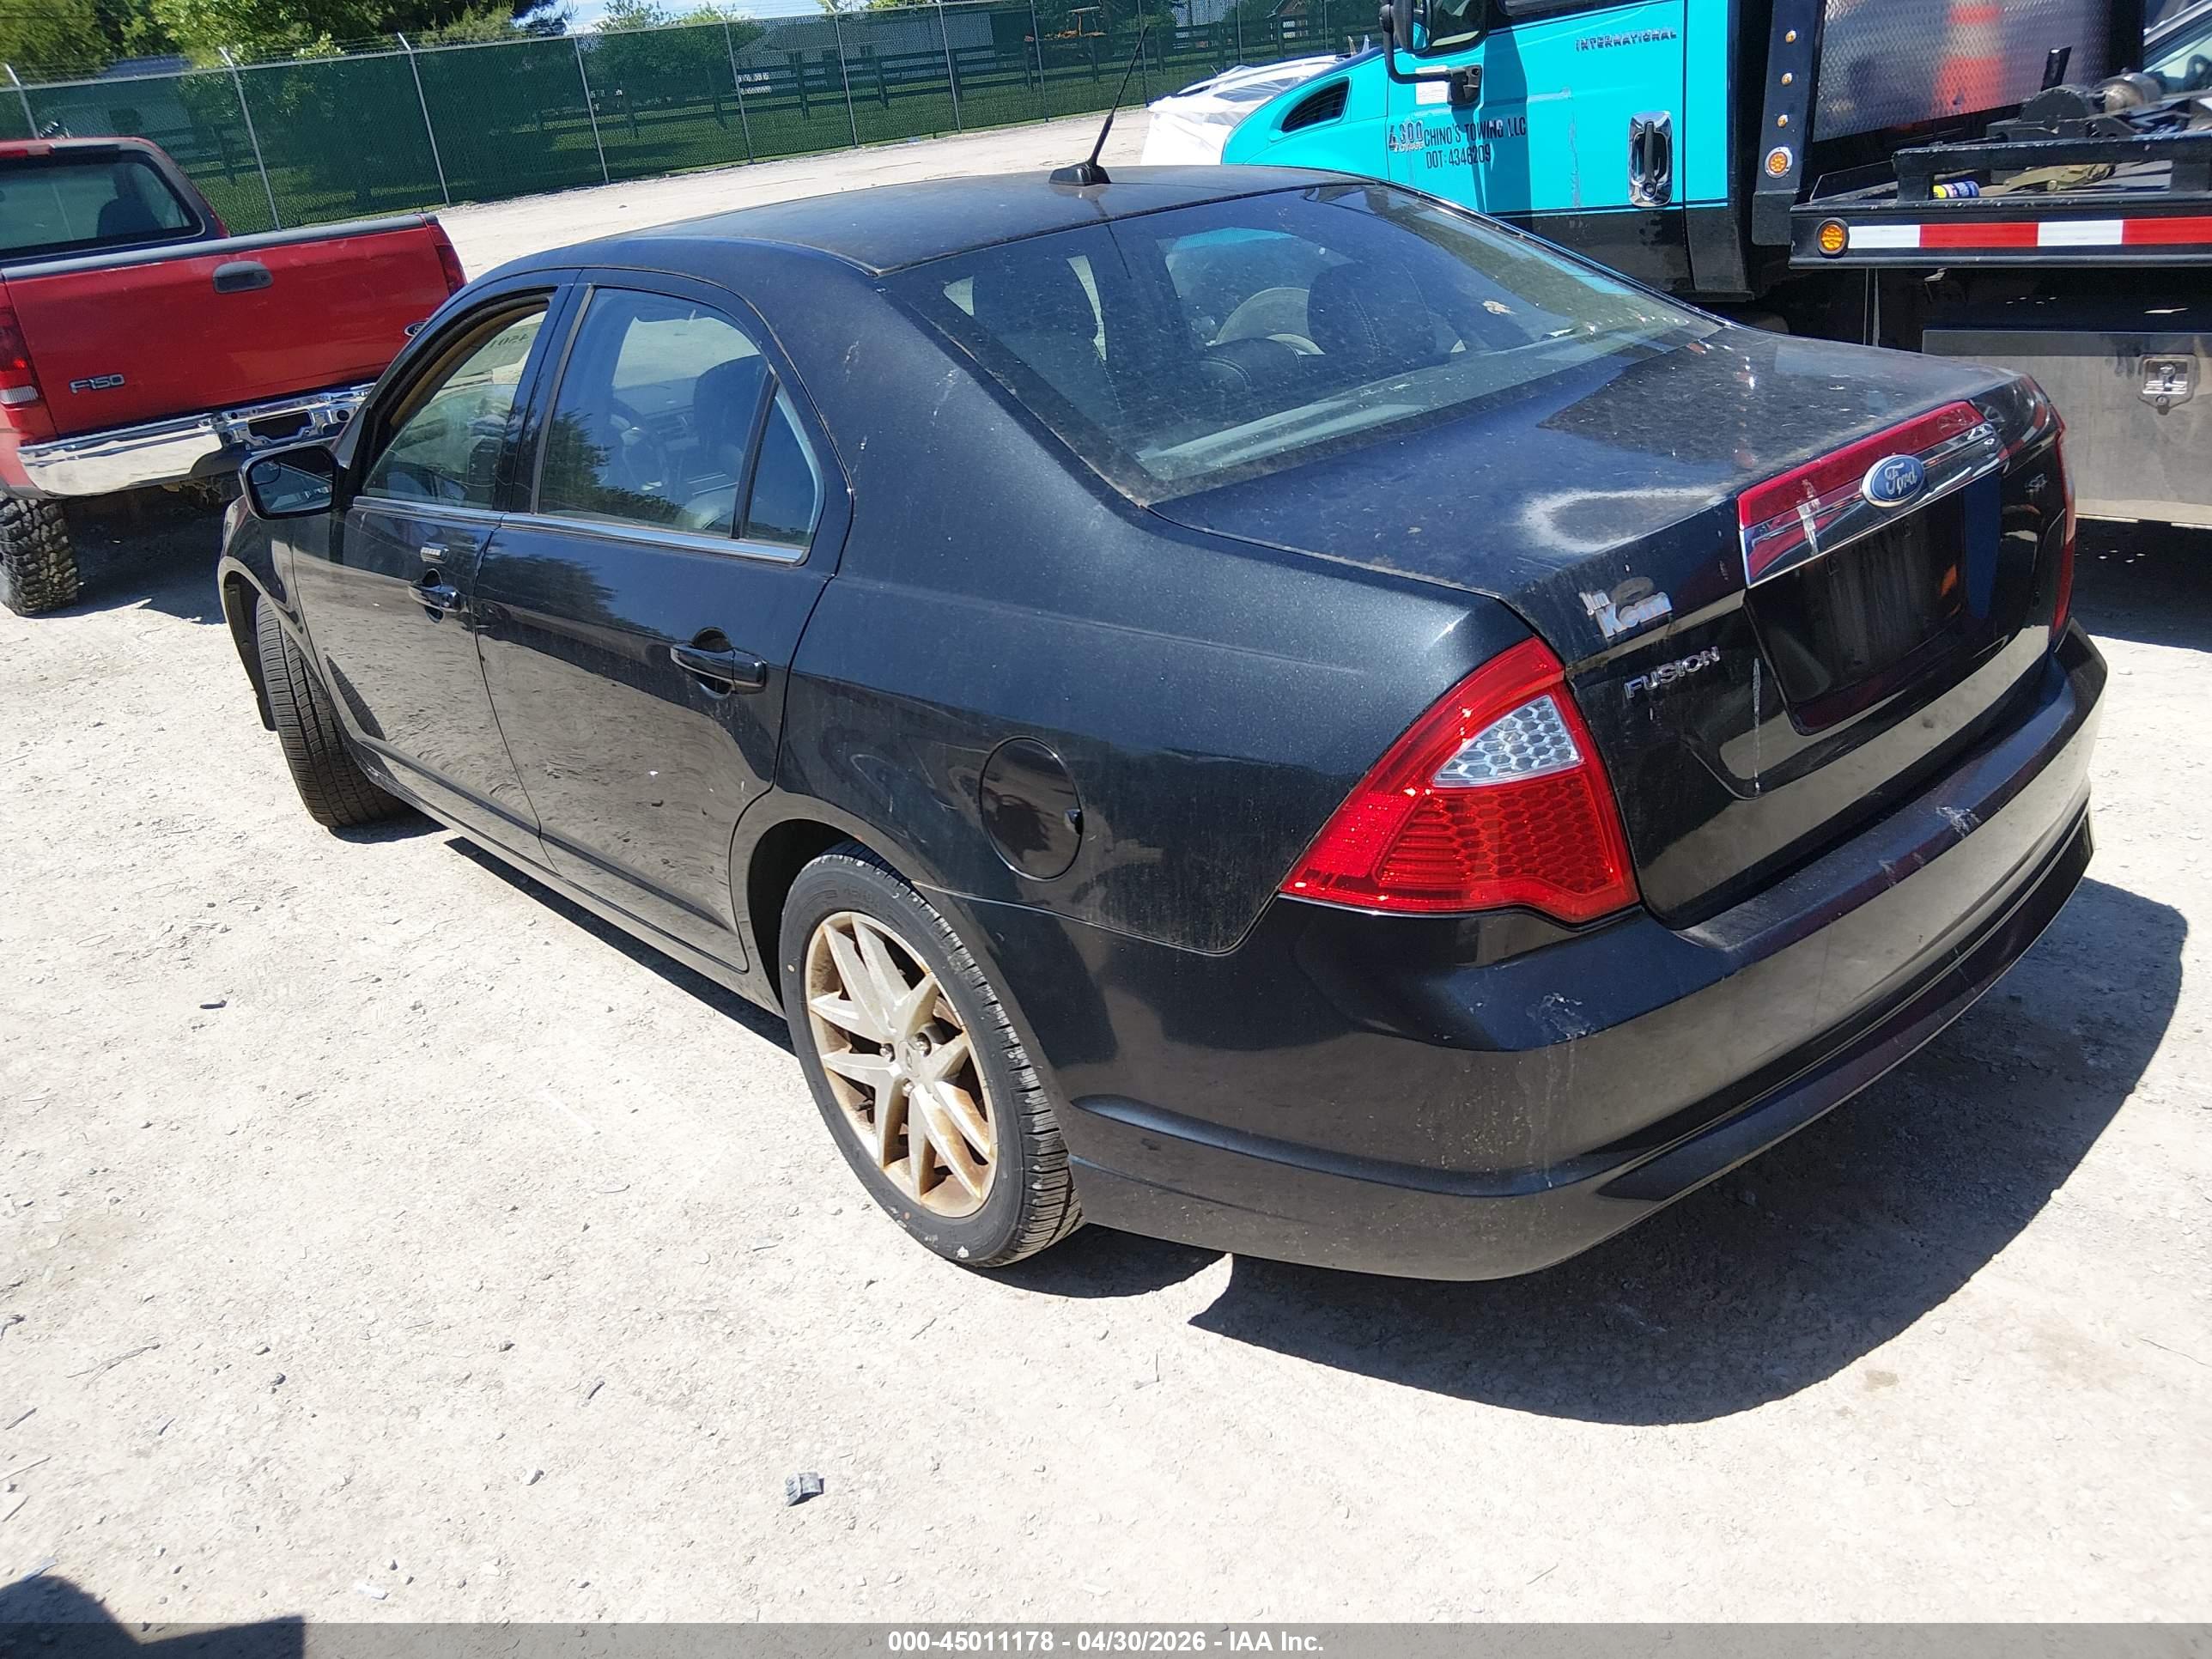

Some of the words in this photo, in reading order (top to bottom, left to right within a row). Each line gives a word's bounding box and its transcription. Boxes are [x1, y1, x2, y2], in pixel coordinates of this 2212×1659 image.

[1575, 29, 1677, 52] INTERNATIONAL
[1424, 124, 1461, 147] CHINO'S
[1464, 118, 1504, 142] TOWING
[1507, 116, 1527, 137] LLC
[1884, 462, 1917, 495] Ford
[1624, 646, 1721, 699] FUSION
